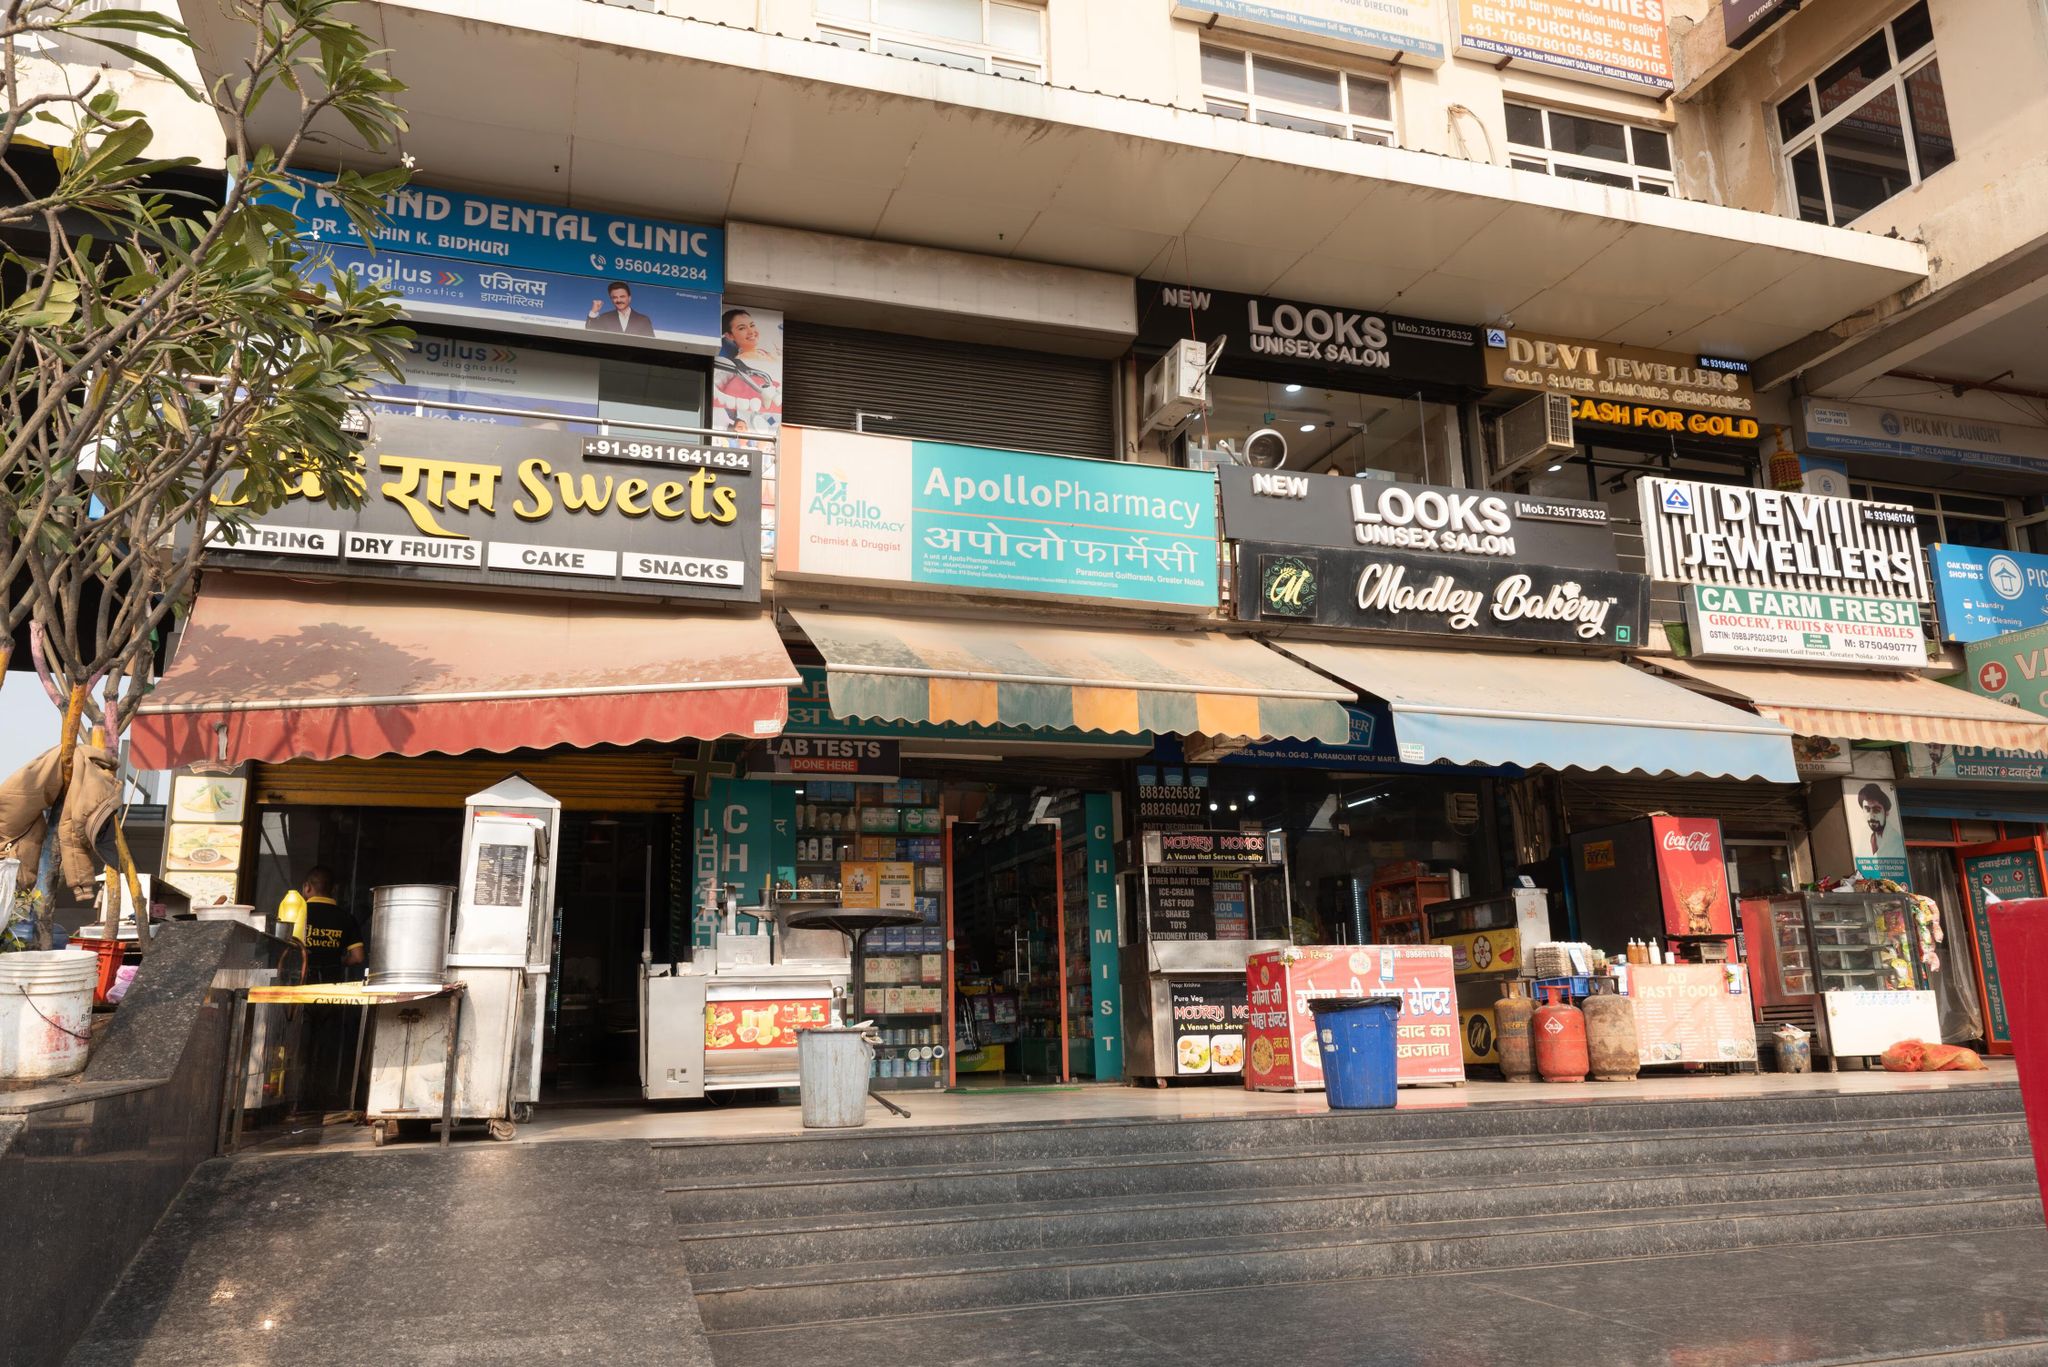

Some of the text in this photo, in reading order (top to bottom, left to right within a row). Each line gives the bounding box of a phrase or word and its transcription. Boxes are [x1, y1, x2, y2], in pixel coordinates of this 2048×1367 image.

[1364, 1, 1409, 17] DIRECTION
[1530, 1, 1627, 32] turn your vision into
[1467, 22, 1497, 37] +91-
[1472, 4, 1662, 59] RENT PURCHASE SALE
[1476, 40, 1496, 52] OFFICE
[1604, 66, 1627, 78] GREATER
[312, 218, 510, 256] DR. K. BIDHURI
[464, 200, 708, 258] DENTAL CLINIC
[348, 259, 433, 285] agilus
[615, 257, 708, 281] 9560428284
[384, 283, 464, 298] diagnostics
[479, 271, 548, 297] एजिलस
[1162, 288, 1211, 310] NEW
[1248, 300, 1389, 350] LOOKS
[408, 338, 487, 362] agilus
[1251, 334, 1391, 369] UNISEX SALON
[442, 359, 518, 375] diagnostics
[1507, 337, 1739, 391] DEVI JEWELLERS
[426, 369, 450, 379] Largest
[450, 372, 486, 382] Diagnostics
[487, 376, 516, 385] Company
[1504, 367, 1752, 411] GOLD SILVER DIAMONDS GEMSTONES
[1570, 400, 1759, 439] CASH FOR GOLD
[1903, 416, 2001, 443] PICK MY LAUNDRY
[586, 440, 750, 468] +91-9811641434
[512, 458, 738, 524] Sweets
[1252, 473, 1309, 499] NEW
[808, 495, 881, 526] Apollo
[1349, 483, 1511, 536] LOOKS
[1521, 502, 1607, 521] Mob.7351736332
[1718, 488, 1842, 535] DEVI
[1863, 508, 1915, 525] M: 9319461741
[836, 517, 905, 533] PHARMACY
[810, 535, 901, 552] Chemist & Druggist
[923, 522, 1199, 574] अपोलो फार्मेसी
[1355, 523, 1517, 556] UNISEX SALON
[351, 537, 476, 561] DRY FRUITS
[1684, 531, 1915, 584] JEWELLERS
[522, 550, 585, 568] CAKE
[1946, 561, 1983, 571] OAK TOWER
[639, 559, 729, 580] SNACKS
[1075, 568, 1114, 578] Paramount
[1157, 575, 1183, 584] Greater
[1184, 578, 1205, 586] Noida
[1948, 570, 1979, 580] SHOP NO
[1357, 563, 1610, 639] Madley Bakery
[1701, 587, 1917, 625] CA FARM FRESH
[1976, 600, 2005, 611] Laundry
[1708, 613, 1914, 639] GROCERY, FRUITS & VEGETABLES
[1978, 615, 2022, 627] Dry Cleaning
[1709, 630, 1731, 640] GSTIN:
[1753, 645, 1790, 655] Paramount
[1829, 651, 1855, 660] Greater
[1855, 653, 1874, 661] Noida
[1844, 638, 1918, 653] M: 8750490777
[1968, 641, 1992, 652] GSTIN
[766, 738, 881, 759] LAB TESTS
[1258, 750, 1275, 759] Shop
[1313, 753, 1356, 762] PARAMOUNT
[794, 759, 855, 771] DONE HERE
[1957, 764, 2000, 777] CHEMIST
[1139, 785, 1201, 800] 8882626582
[1140, 802, 1201, 816] 8882604027
[1162, 835, 1265, 853] MODREN MOMOS
[1663, 830, 1713, 852] Coca-Cola
[1212, 853, 1236, 861] Serves
[1237, 853, 1264, 863] Quality
[1178, 866, 1199, 875] ITEMS
[1169, 877, 1211, 886] DAIRY ITEMS
[1158, 887, 1195, 897] ICE-CREAM
[1160, 899, 1195, 907] FAST FOOD
[1165, 909, 1190, 918] SHAKES
[1169, 920, 1187, 929] TOYS
[1094, 825, 1115, 1051] CHEMIST
[1150, 931, 1209, 941] STATIONERY ITEMS
[1173, 994, 1204, 1003] Pure Veg
[1408, 977, 1452, 1016] सेन्टर
[1638, 984, 1718, 998] FAST FOOD
[1173, 1004, 1225, 1022] MODREN
[1179, 1022, 1224, 1031] A Venue that
[1429, 1023, 1452, 1039] का
